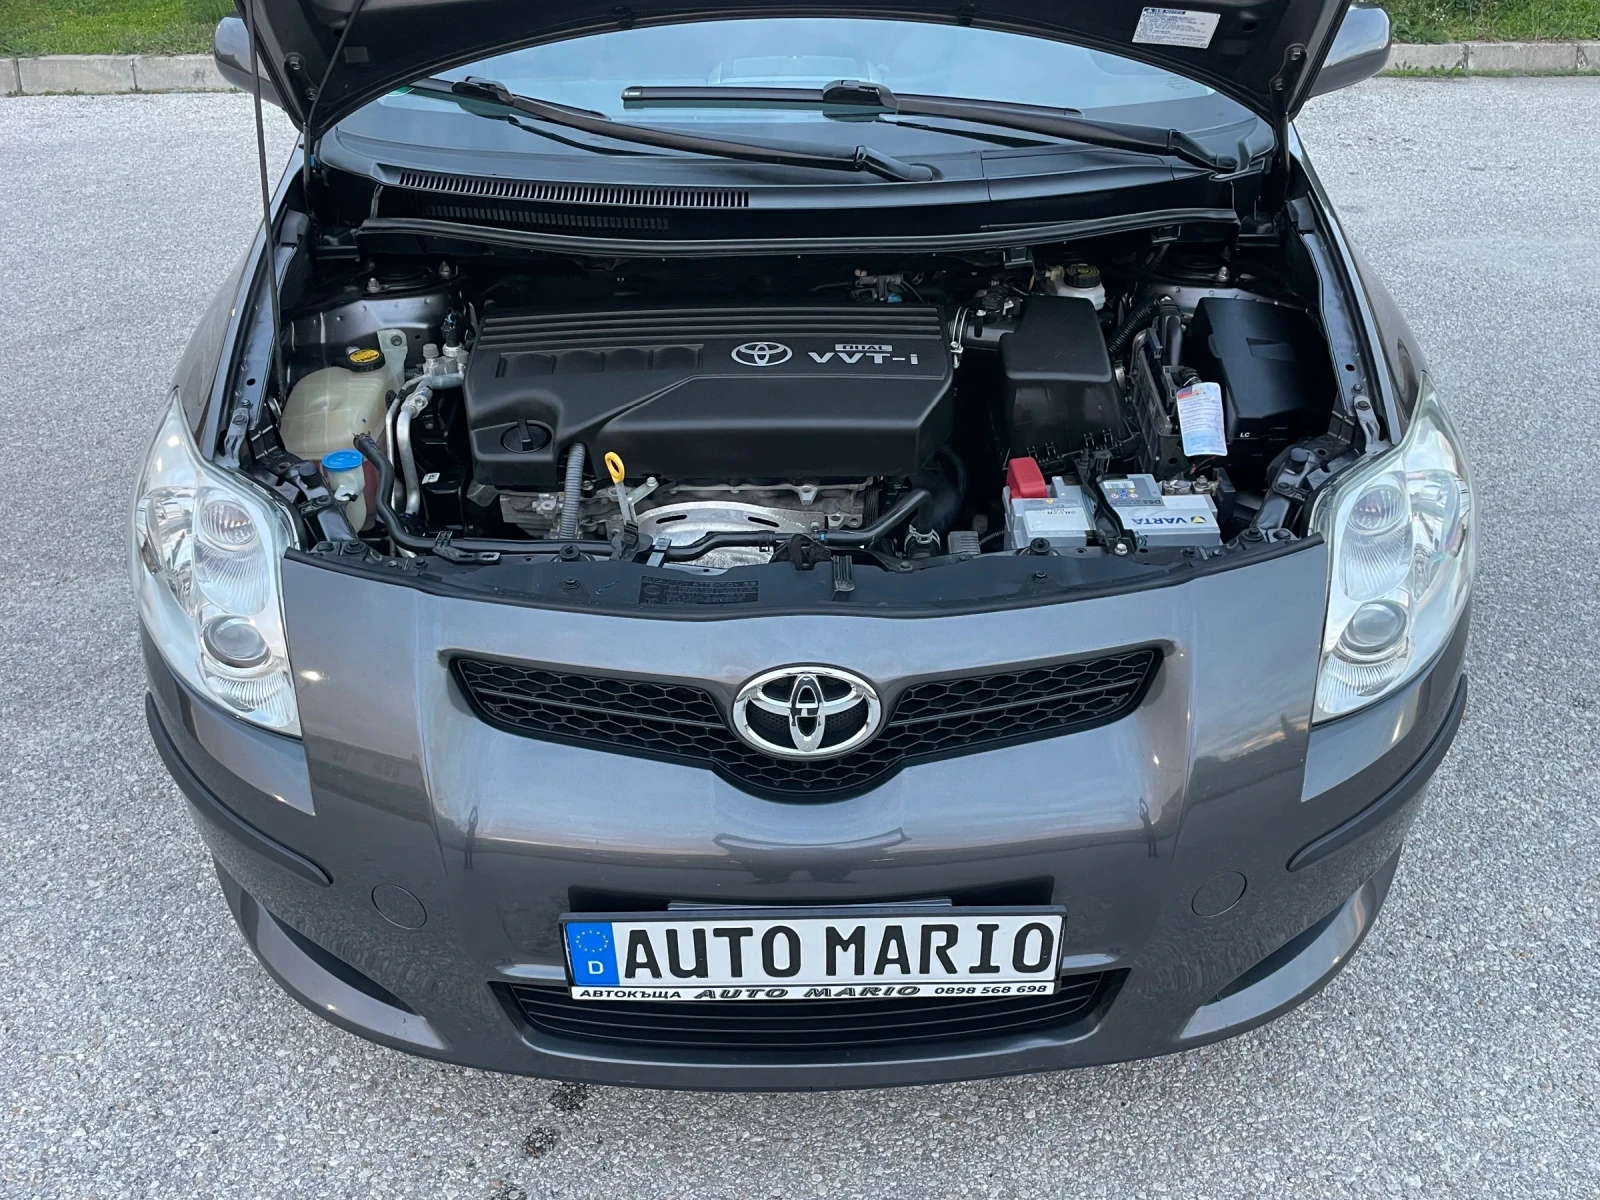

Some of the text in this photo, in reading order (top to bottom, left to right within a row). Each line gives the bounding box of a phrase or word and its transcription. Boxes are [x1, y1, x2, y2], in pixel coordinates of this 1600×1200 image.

[807, 352, 919, 365] VVT-i
[624, 922, 1055, 979] AUTO MARIO
[588, 960, 604, 975] D
[579, 985, 1047, 999] АВТОКЪЩА AUTO MARIO 0898 568 698
